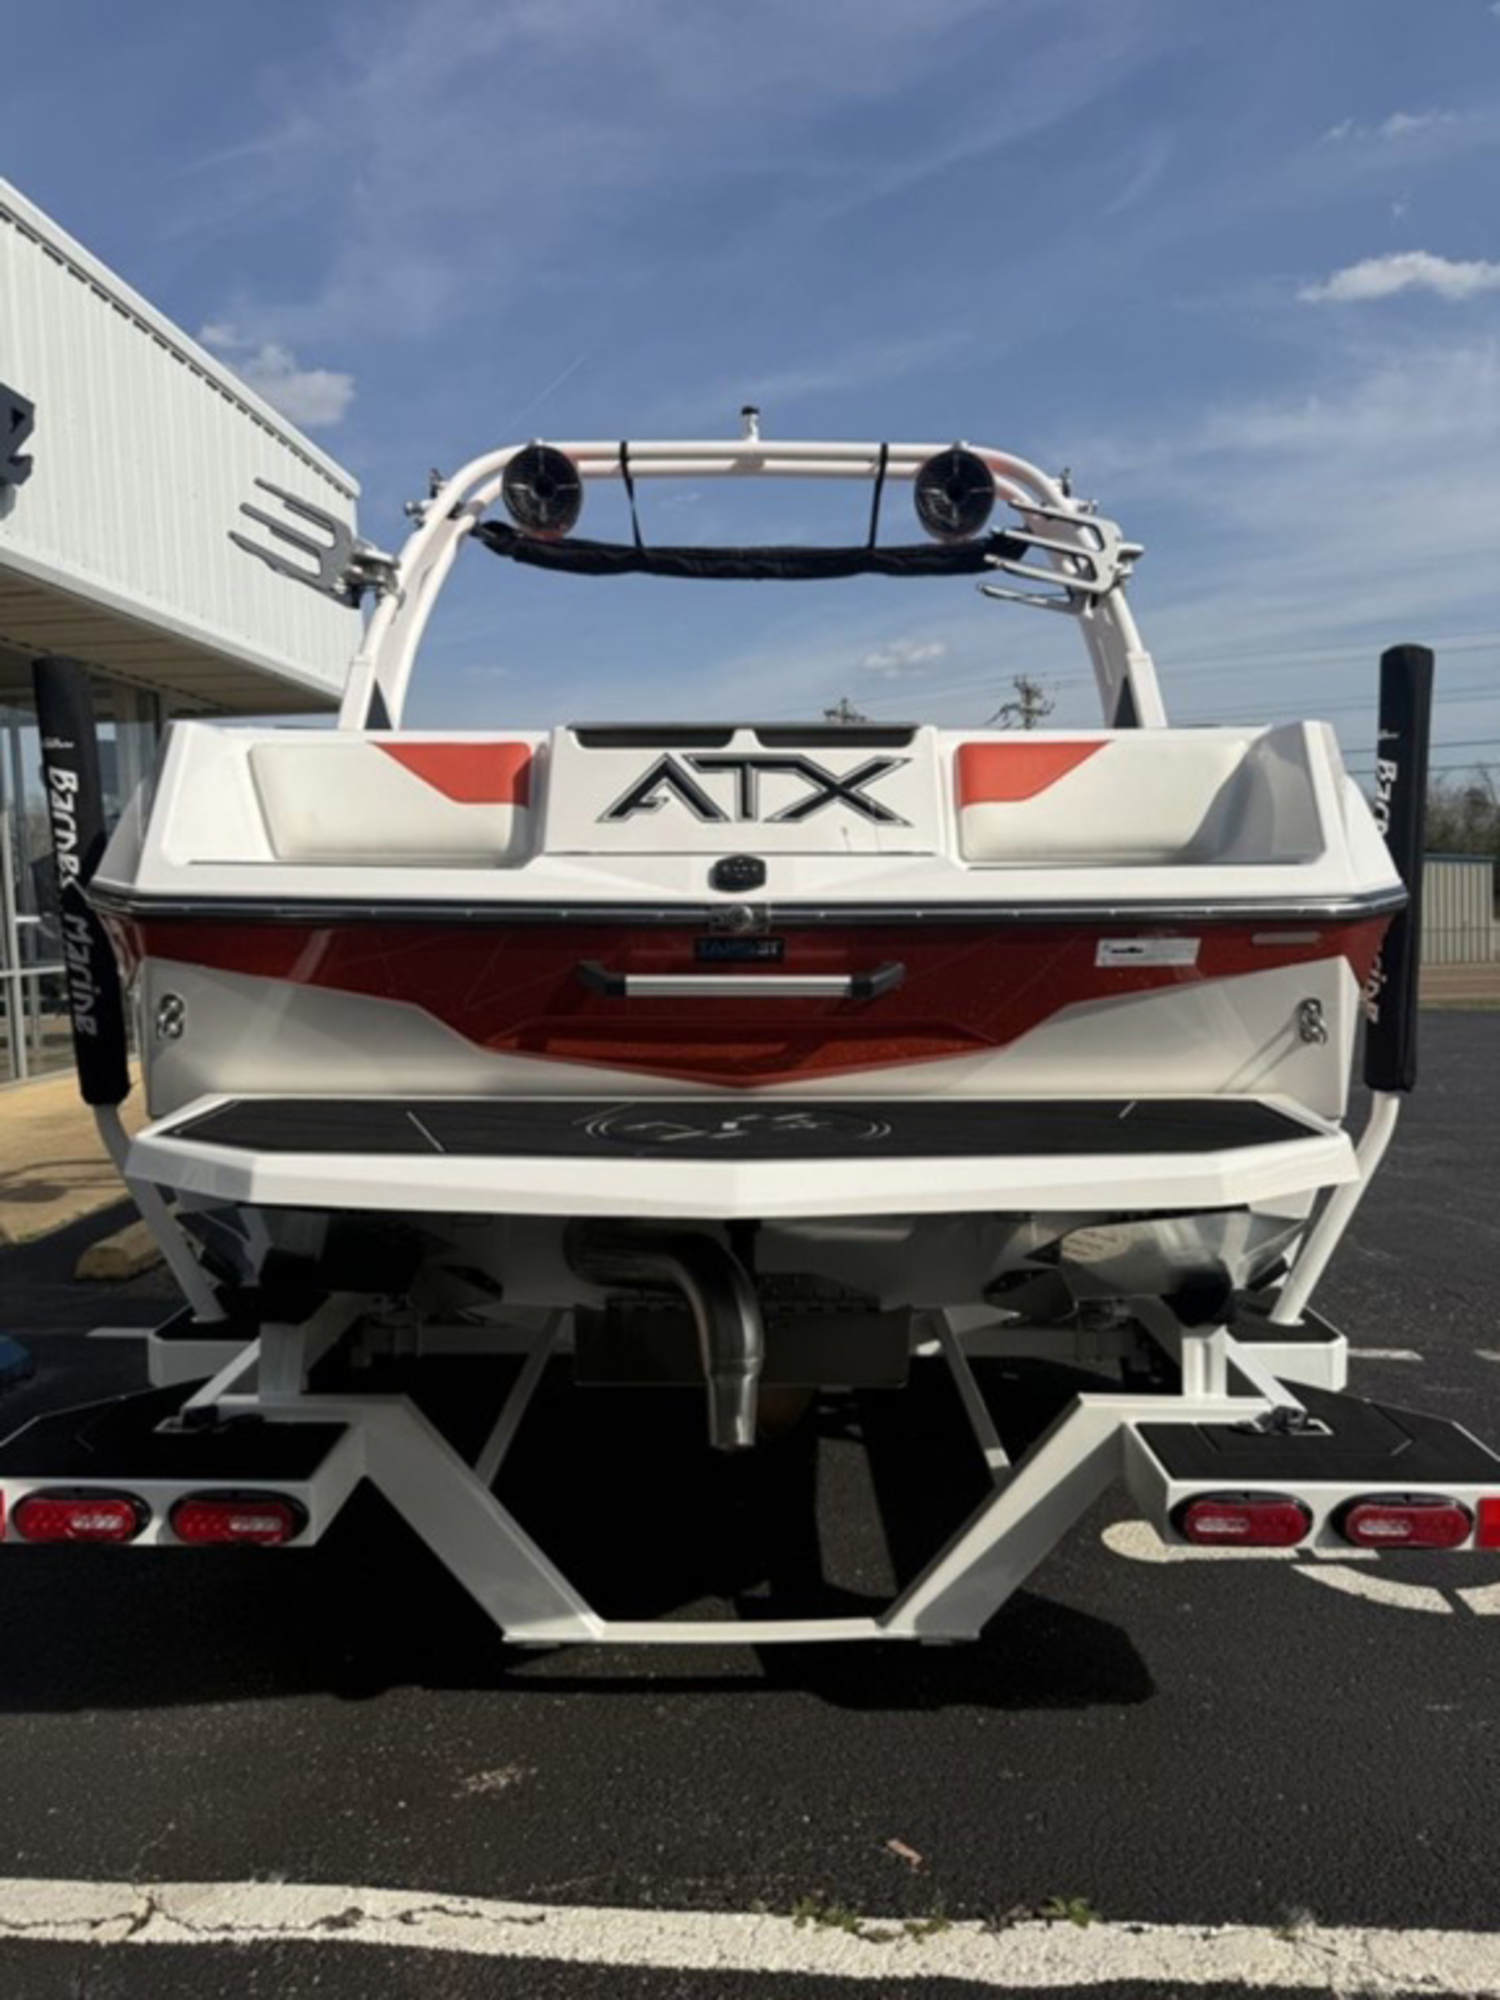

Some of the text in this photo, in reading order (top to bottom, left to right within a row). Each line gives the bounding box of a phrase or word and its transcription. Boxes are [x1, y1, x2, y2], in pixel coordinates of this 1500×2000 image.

[596, 752, 914, 827] ATX
[1375, 759, 1397, 837] Barn
[63, 913, 101, 1036] Marine
